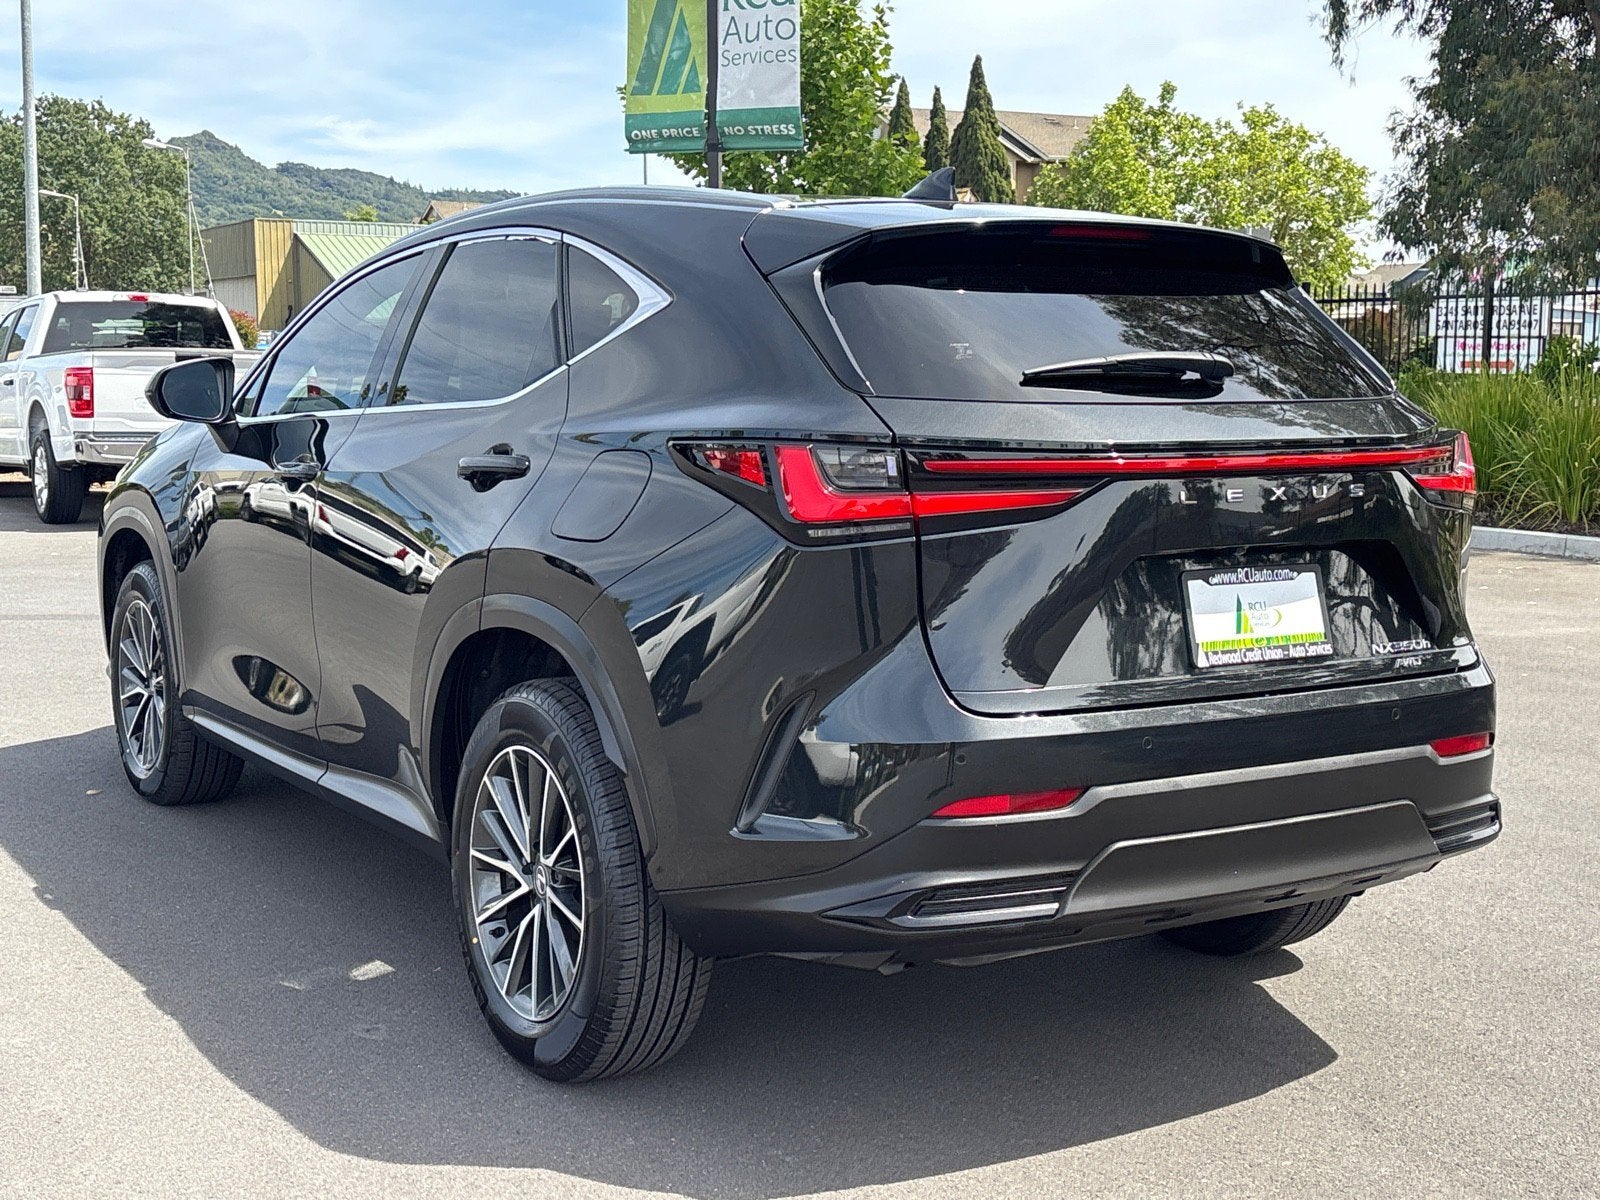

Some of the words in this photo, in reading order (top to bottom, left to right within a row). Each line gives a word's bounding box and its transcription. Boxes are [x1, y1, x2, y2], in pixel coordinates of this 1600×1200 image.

[722, 14, 797, 46] Auto
[720, 46, 797, 68] Services
[630, 128, 660, 141] ONE
[661, 126, 701, 138] PRICE
[723, 125, 745, 137] NO
[747, 123, 796, 136] STRESS
[1467, 319, 1490, 331] ROS
[1179, 483, 1365, 504] LEXUS
[1214, 567, 1291, 584] www.RCUauto.com
[1248, 600, 1267, 612] RCU
[1208, 650, 1241, 666] Redwood
[1241, 646, 1262, 662] Credit
[1262, 644, 1284, 660] Union
[1289, 643, 1306, 658] Auto
[1306, 641, 1333, 656] Services
